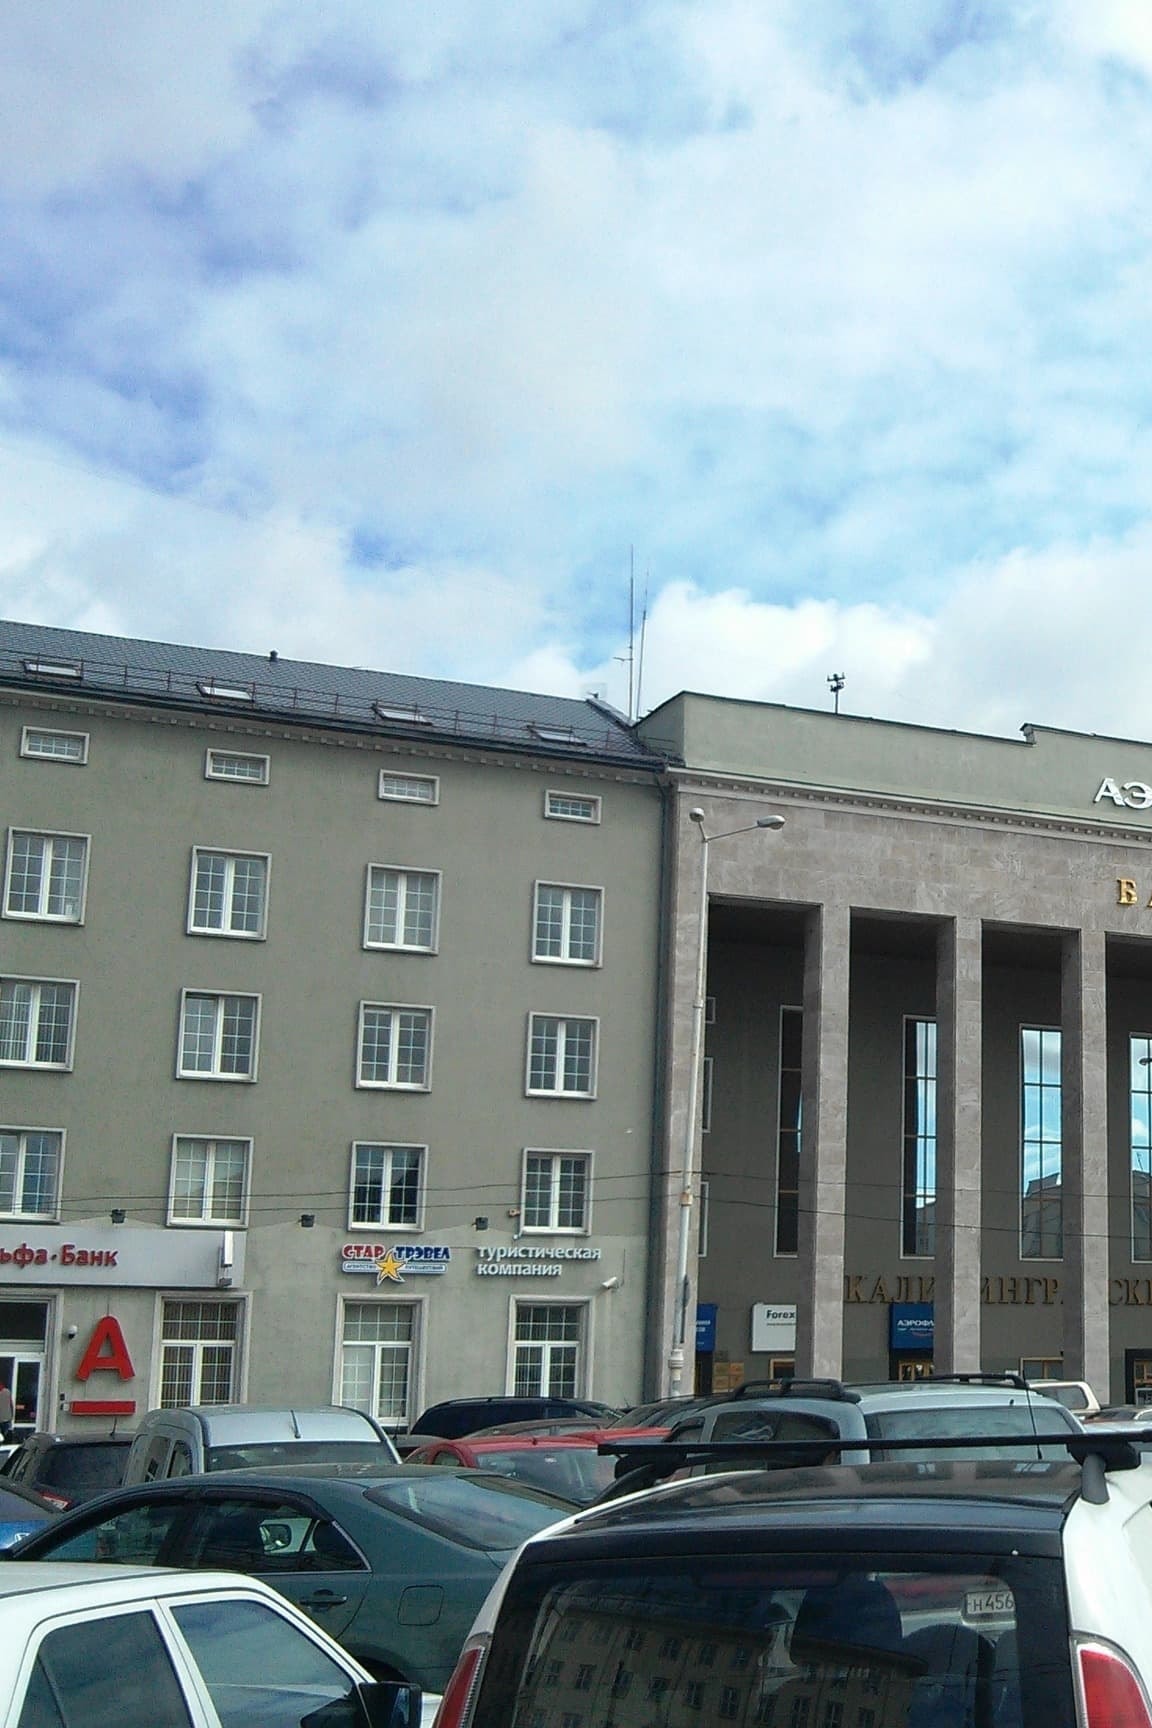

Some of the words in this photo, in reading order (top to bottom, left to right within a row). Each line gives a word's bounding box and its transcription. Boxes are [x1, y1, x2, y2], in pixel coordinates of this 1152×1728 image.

[343, 1244, 384, 1259] СТАР
[395, 1246, 451, 1260] ТРЭВЕЛ
[478, 1246, 601, 1262] туристическая
[477, 1263, 563, 1276] компания
[766, 1309, 796, 1319] Forex
[896, 1319, 935, 1328] АЭРОФЛ
